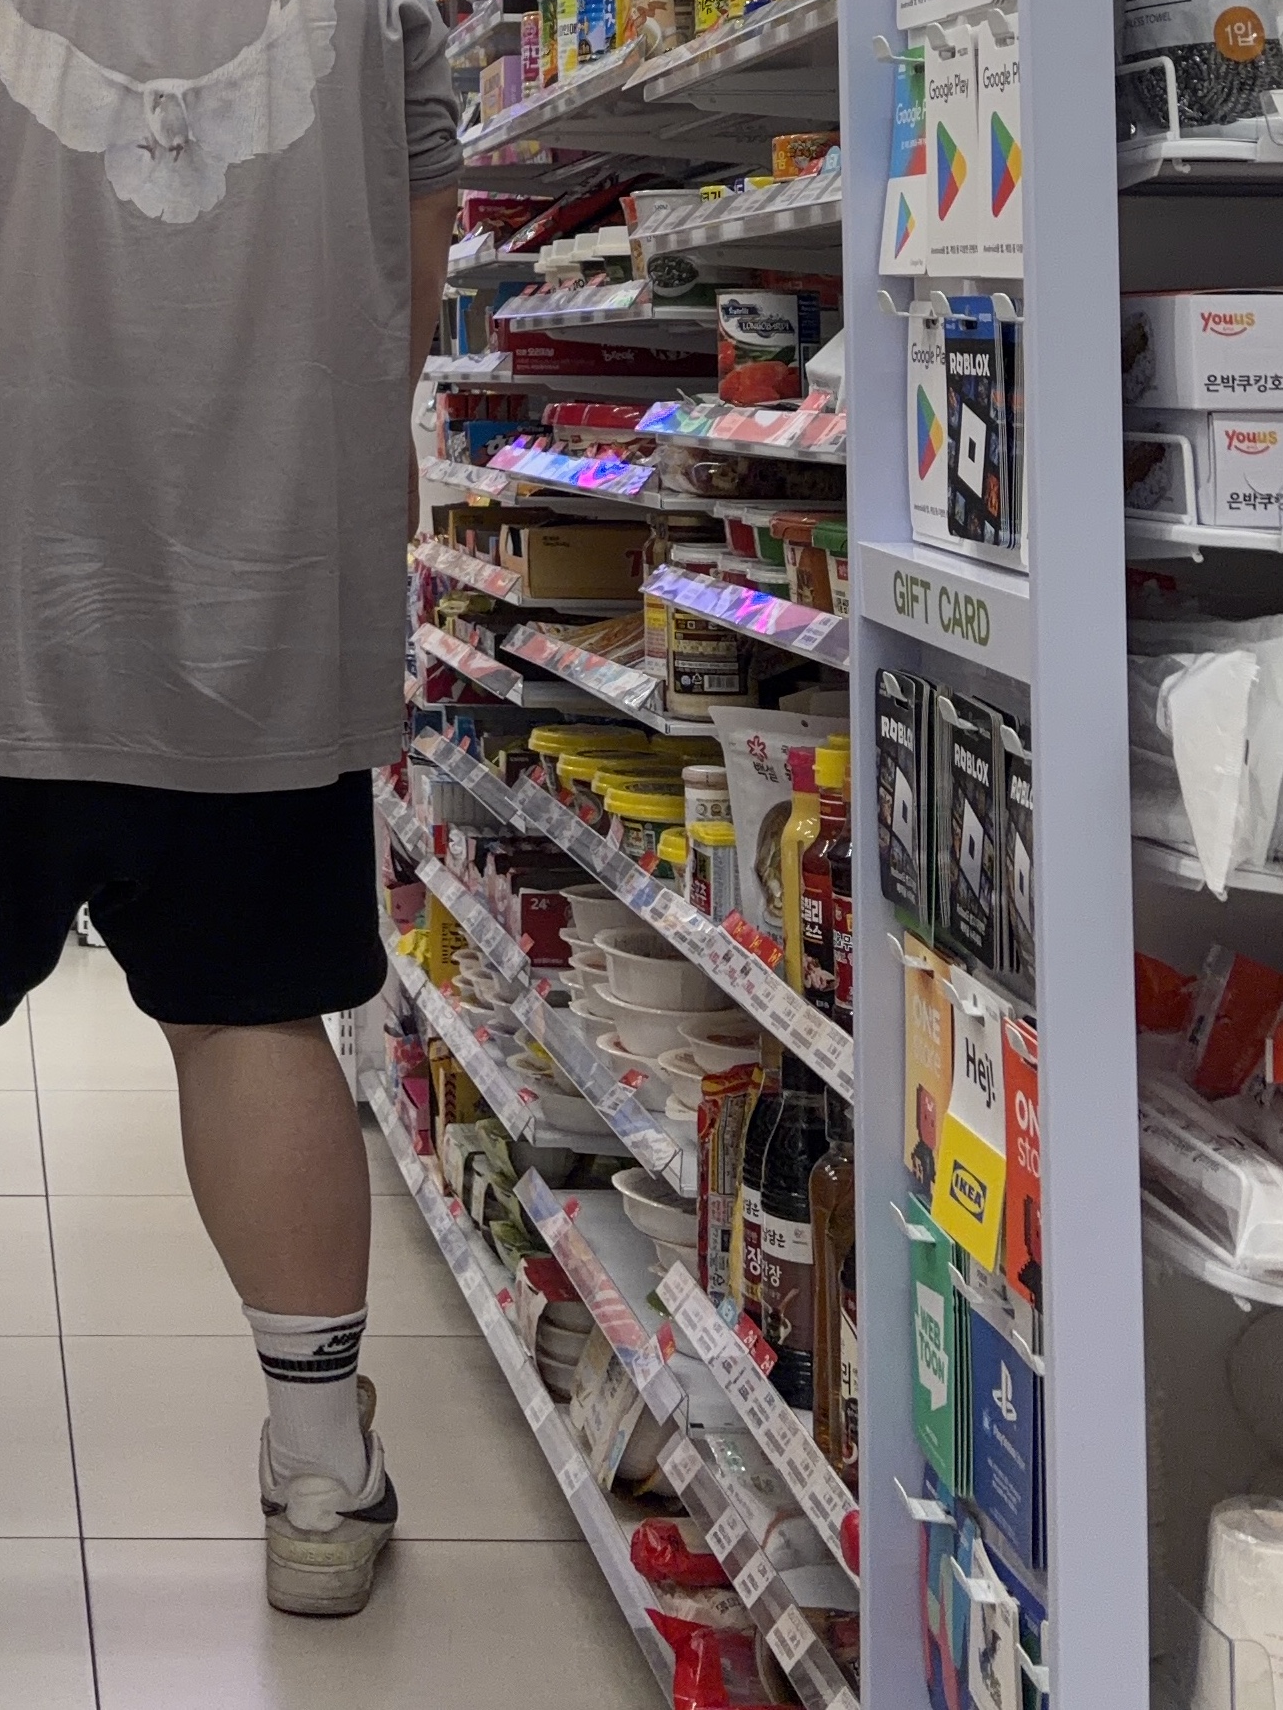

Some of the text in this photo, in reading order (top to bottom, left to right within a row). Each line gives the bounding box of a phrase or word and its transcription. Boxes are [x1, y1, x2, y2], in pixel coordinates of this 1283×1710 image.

[1224, 21, 1257, 47] 1입
[929, 73, 970, 103] Google Play
[983, 63, 1012, 93] Google
[896, 100, 922, 128] Google
[1201, 311, 1256, 333] youus
[911, 343, 935, 369] Google
[949, 353, 991, 377] ROBLOX
[1204, 374, 1283, 394] 은박쿠킹호
[1225, 429, 1279, 451] youus
[893, 570, 990, 647] GIFT CARD
[954, 742, 990, 788] ROBLOX
[965, 1036, 996, 1110] Hej!
[954, 1171, 984, 1212] IKEA
[919, 1305, 942, 1347] WEB
[918, 1335, 946, 1385] TOON
